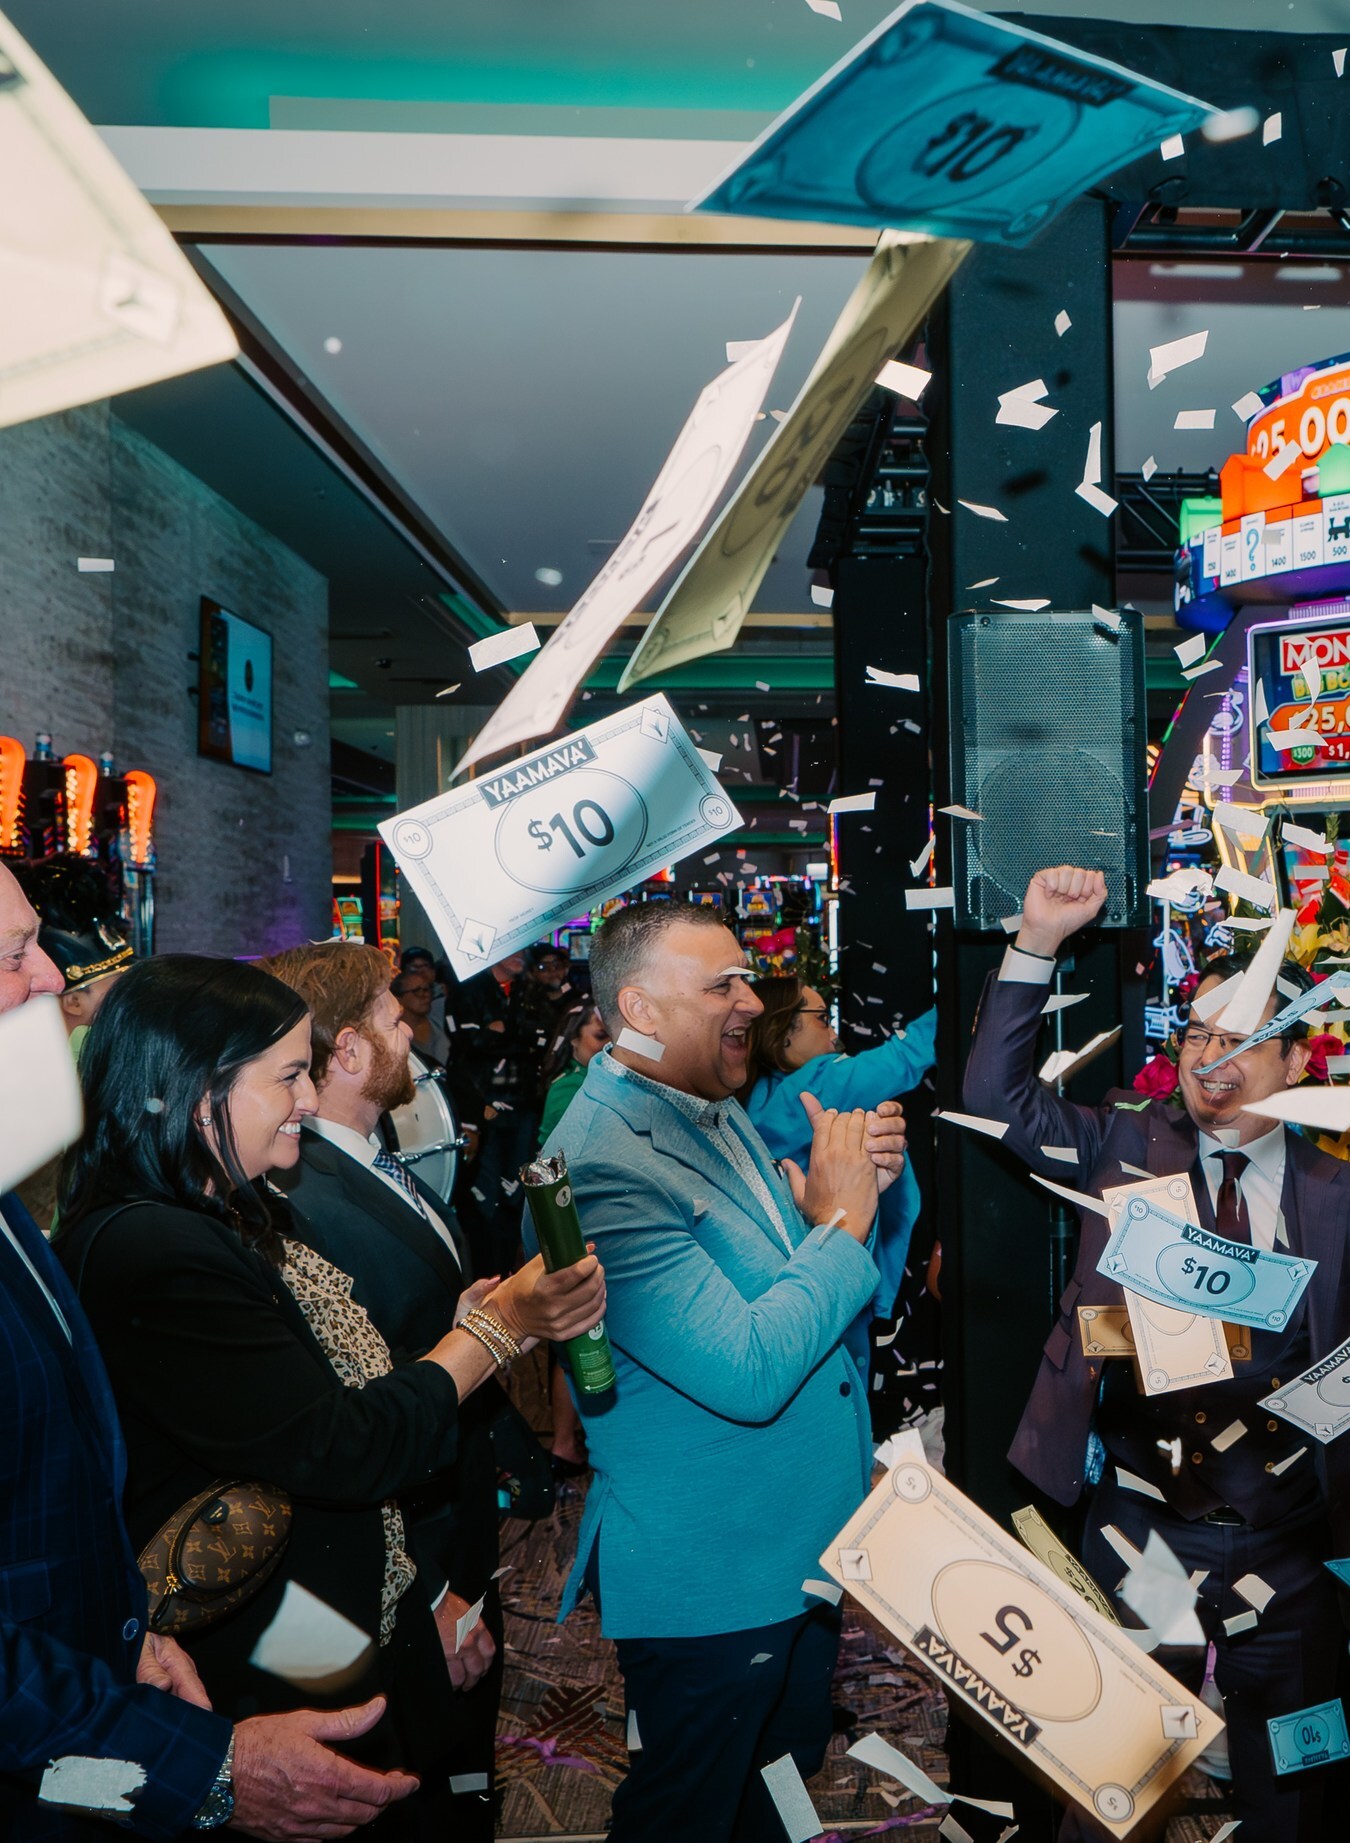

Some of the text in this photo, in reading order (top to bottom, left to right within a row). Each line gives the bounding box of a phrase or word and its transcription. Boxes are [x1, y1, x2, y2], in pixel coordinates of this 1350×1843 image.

[1271, 556, 1287, 567] 1400
[1332, 545, 1348, 556] 500
[484, 741, 588, 802] YAAMAVA'
[708, 806, 723, 817] $10
[403, 832, 421, 845] $10
[527, 799, 615, 859] $10
[1134, 1204, 1144, 1214] $10
[1187, 1228, 1256, 1262] YAAMAVA'
[1180, 1256, 1231, 1295] $10
[979, 1604, 1043, 1679] $5
[918, 1635, 1031, 1742] YAAMAVA'
[1301, 1725, 1322, 1745] $10
